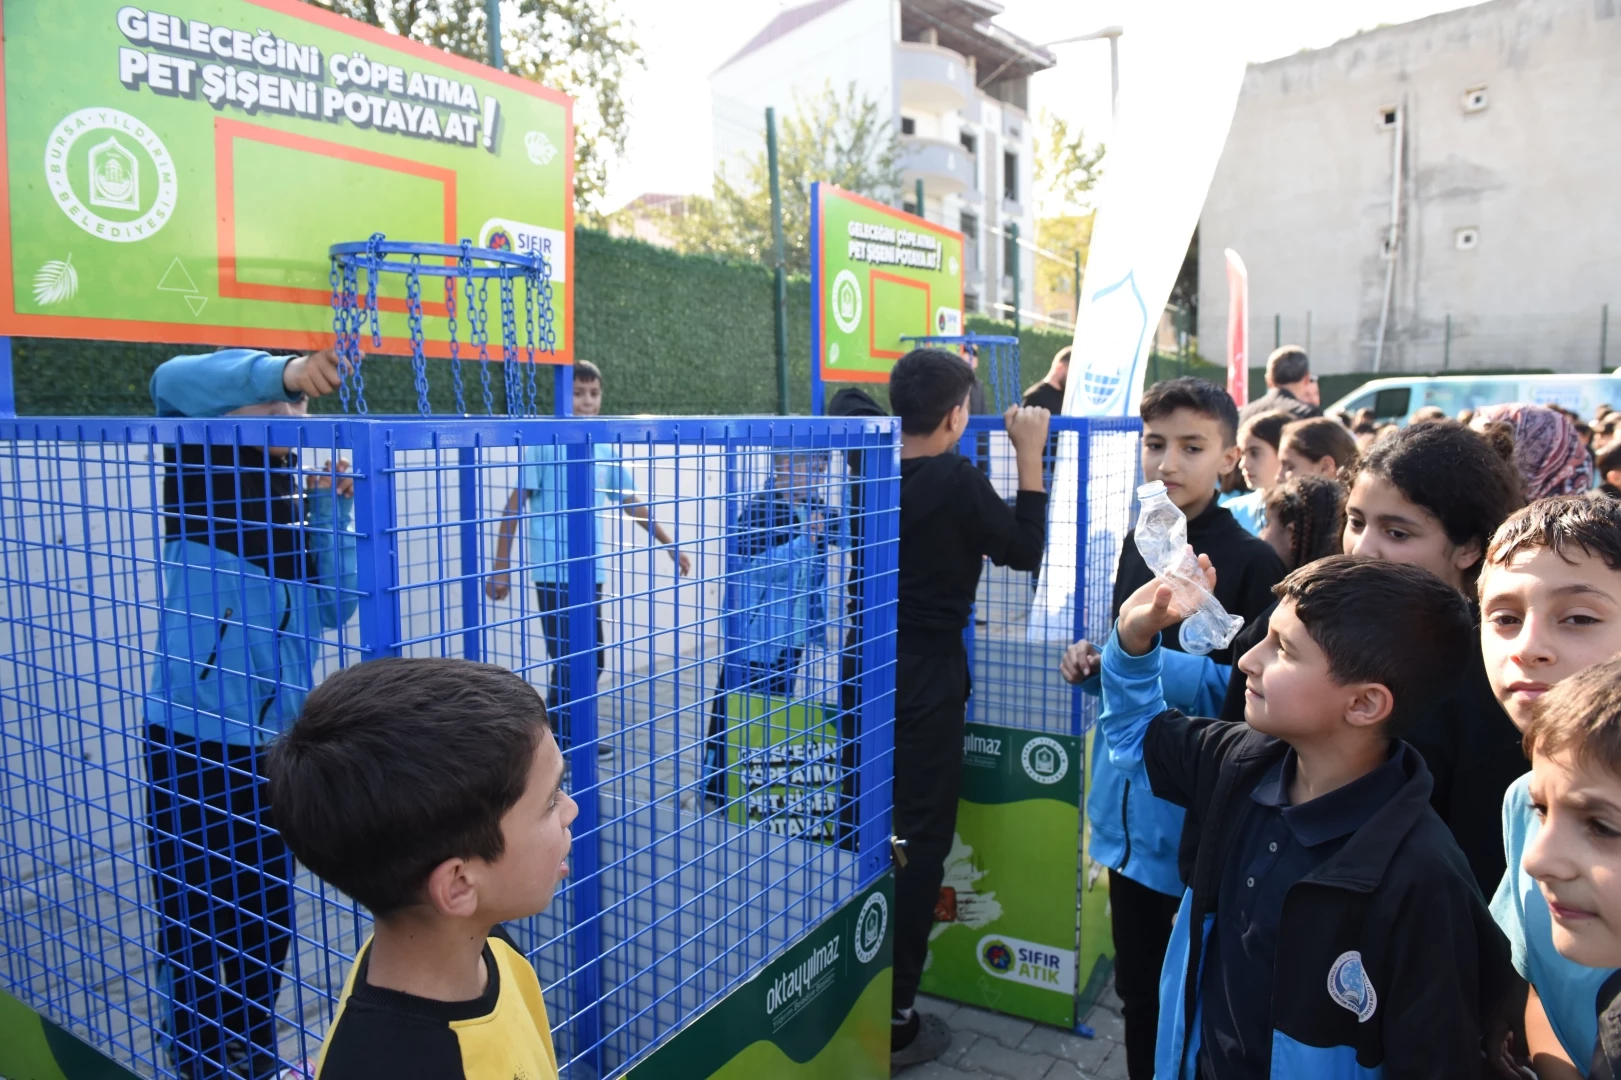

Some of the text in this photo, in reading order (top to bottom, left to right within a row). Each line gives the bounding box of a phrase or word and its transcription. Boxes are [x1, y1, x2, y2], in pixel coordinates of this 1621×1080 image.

[116, 6, 479, 111] GELECEĞİNİ ÇÖPE ATMA
[119, 46, 197, 94] PET
[201, 64, 318, 115] ŞİŞENİ
[323, 86, 442, 137] POTAYA
[50, 117, 86, 174] BURSA
[98, 112, 172, 184] YILDIRIM
[518, 233, 552, 254] SIFIR
[1018, 947, 1060, 970] SIFIR
[1019, 962, 1060, 985] ATIK
